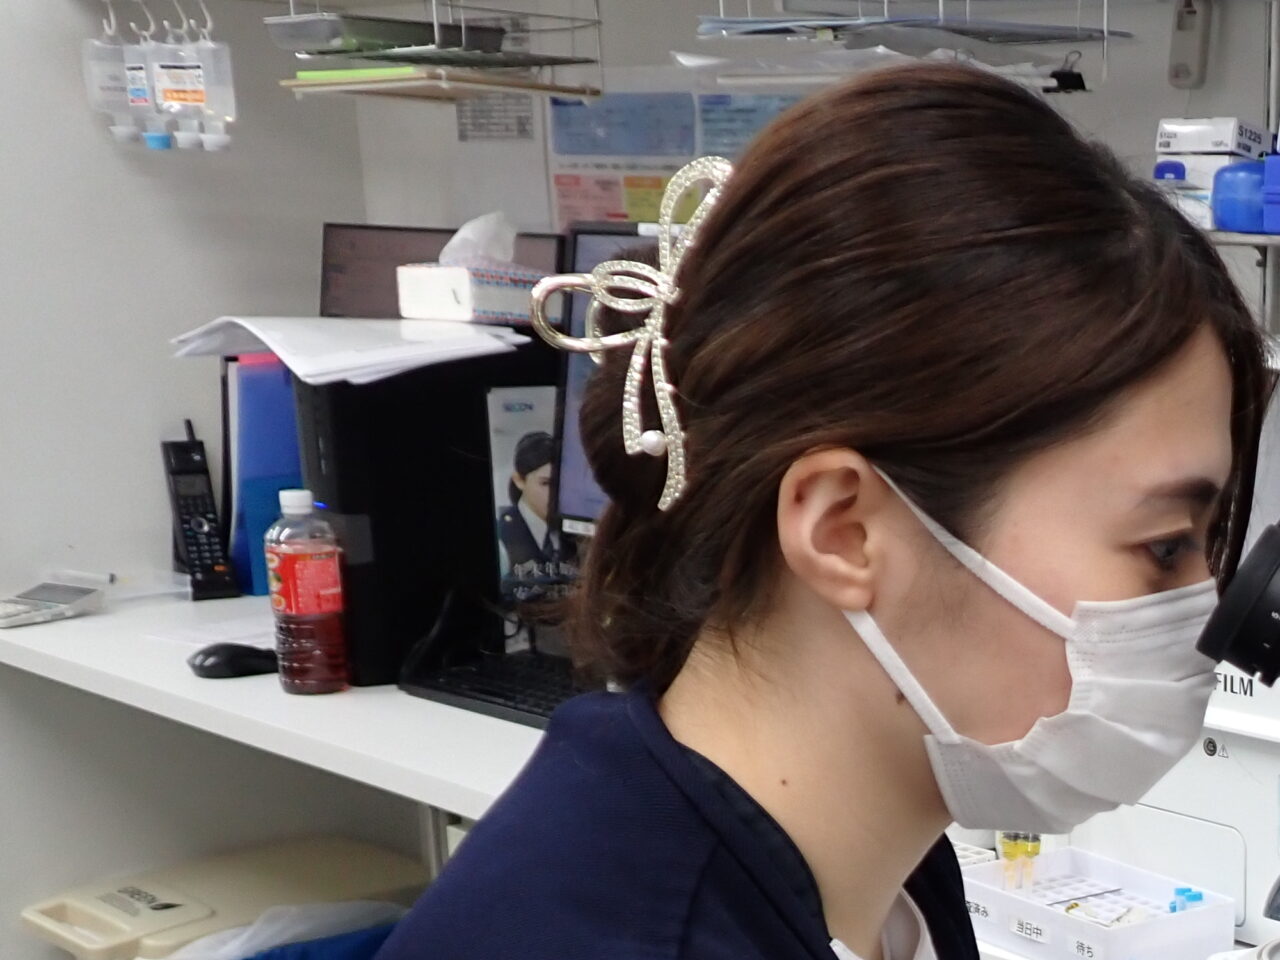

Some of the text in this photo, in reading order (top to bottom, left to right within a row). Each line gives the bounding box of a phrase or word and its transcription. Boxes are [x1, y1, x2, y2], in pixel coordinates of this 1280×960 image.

[1238, 125, 1263, 145] S1225
[1016, 919, 1043, 939] 当日中
[1076, 940, 1094, 959] 待ち
